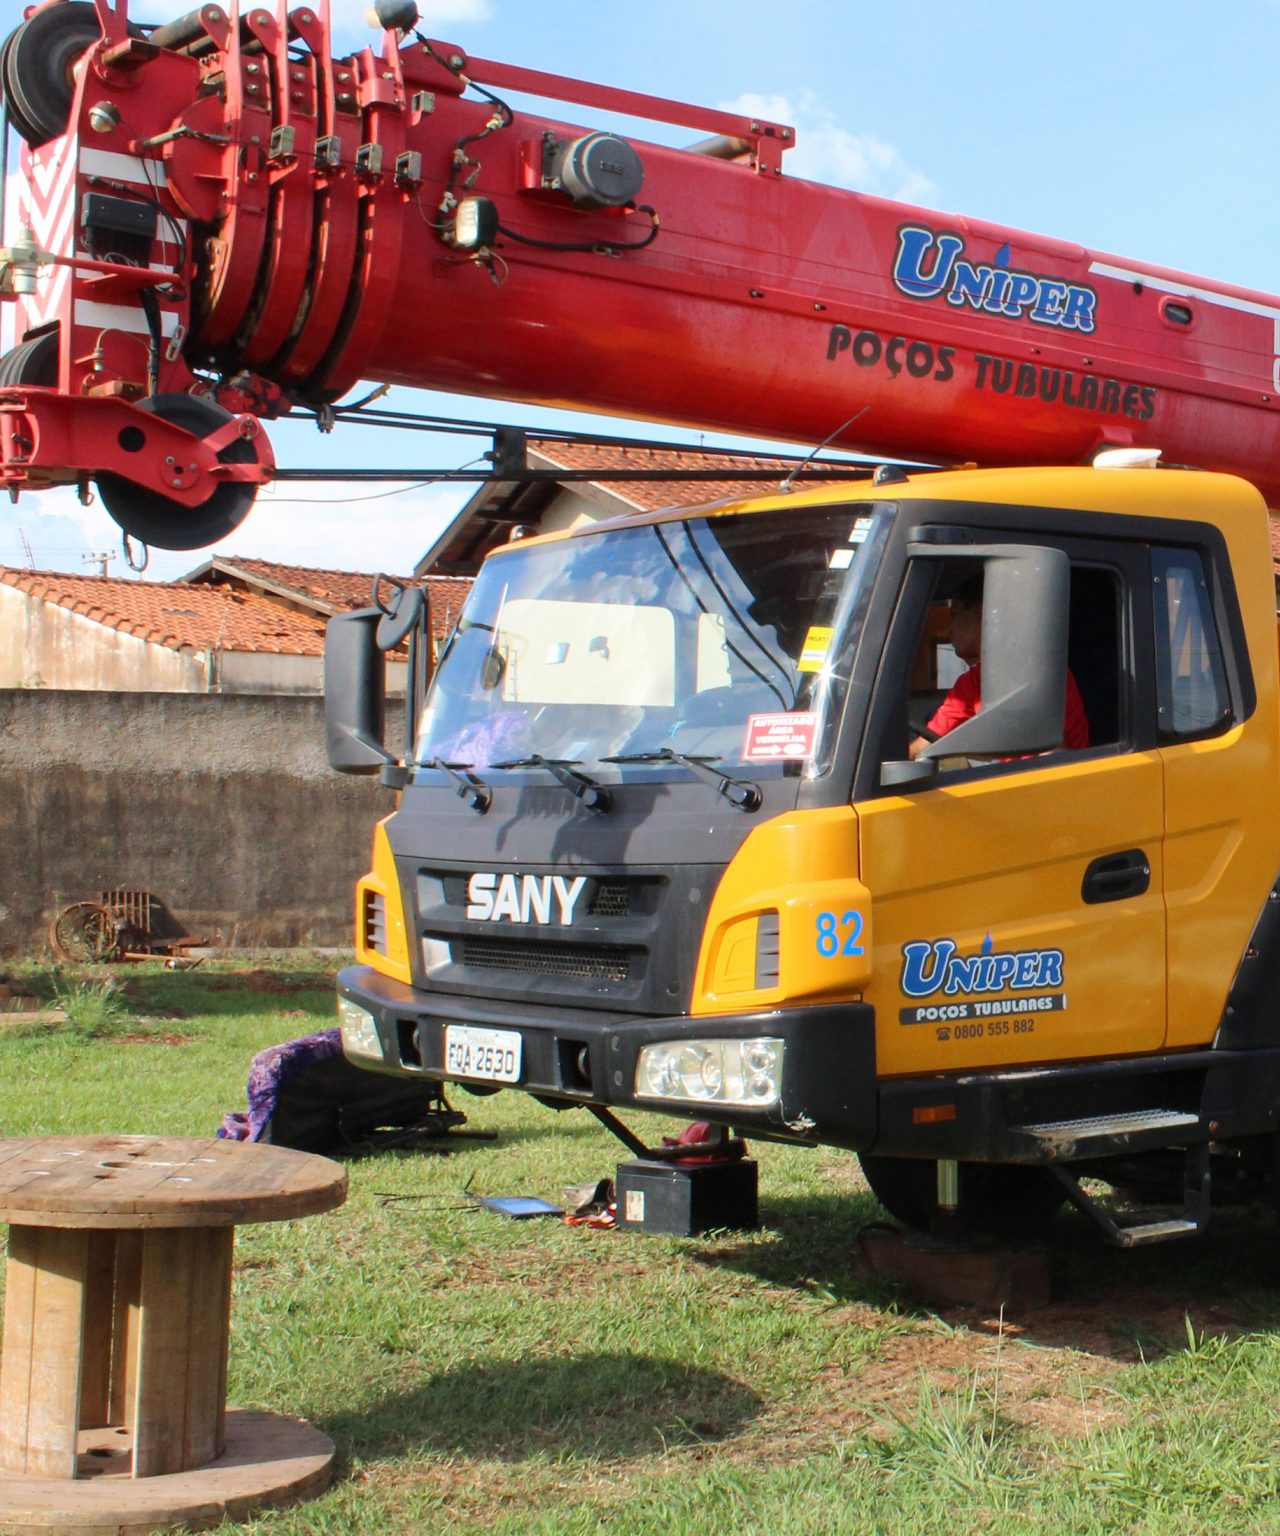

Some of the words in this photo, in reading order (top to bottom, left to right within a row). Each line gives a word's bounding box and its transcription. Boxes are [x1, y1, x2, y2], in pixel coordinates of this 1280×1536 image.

[895, 227, 1096, 333] UNIPER
[826, 323, 957, 382] POÇOS
[974, 352, 1157, 420] TUBULARES
[467, 872, 588, 927] SANY
[816, 910, 864, 958] 82
[902, 940, 1064, 997] UNIPER
[916, 1006, 967, 1022] POÇOS
[974, 997, 1053, 1016] TUBULARES
[954, 1024, 984, 1040] 0800
[988, 1021, 1010, 1037] 555
[1013, 1019, 1035, 1034] 882
